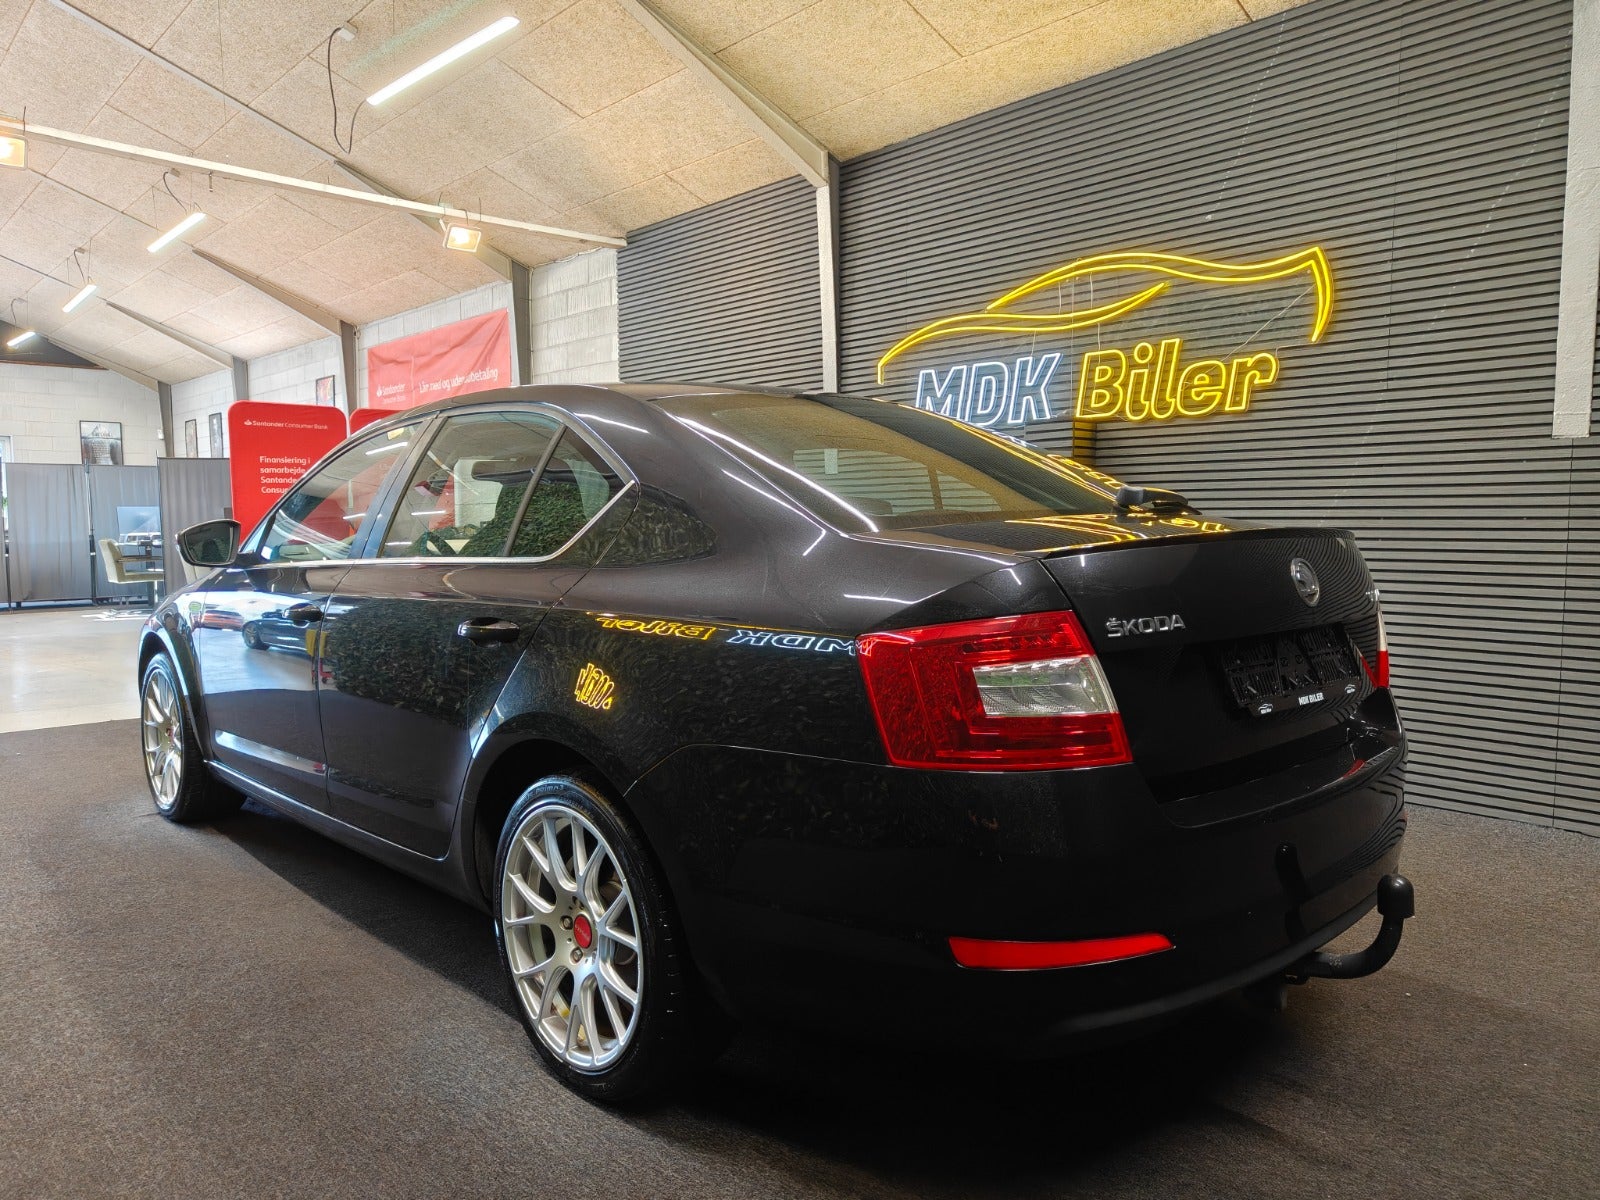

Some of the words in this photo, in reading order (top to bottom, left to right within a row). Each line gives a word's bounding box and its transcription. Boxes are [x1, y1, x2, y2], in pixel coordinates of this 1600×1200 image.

[441, 379, 451, 391] og
[915, 351, 1063, 427] MDK
[1074, 337, 1280, 422] Biler
[252, 420, 284, 428] Santander
[259, 455, 307, 466] Finansiering
[260, 466, 306, 476] samarbejde
[260, 476, 299, 484] Santande
[1105, 614, 1186, 638] ŠKODA
[1309, 692, 1324, 703] BILER
